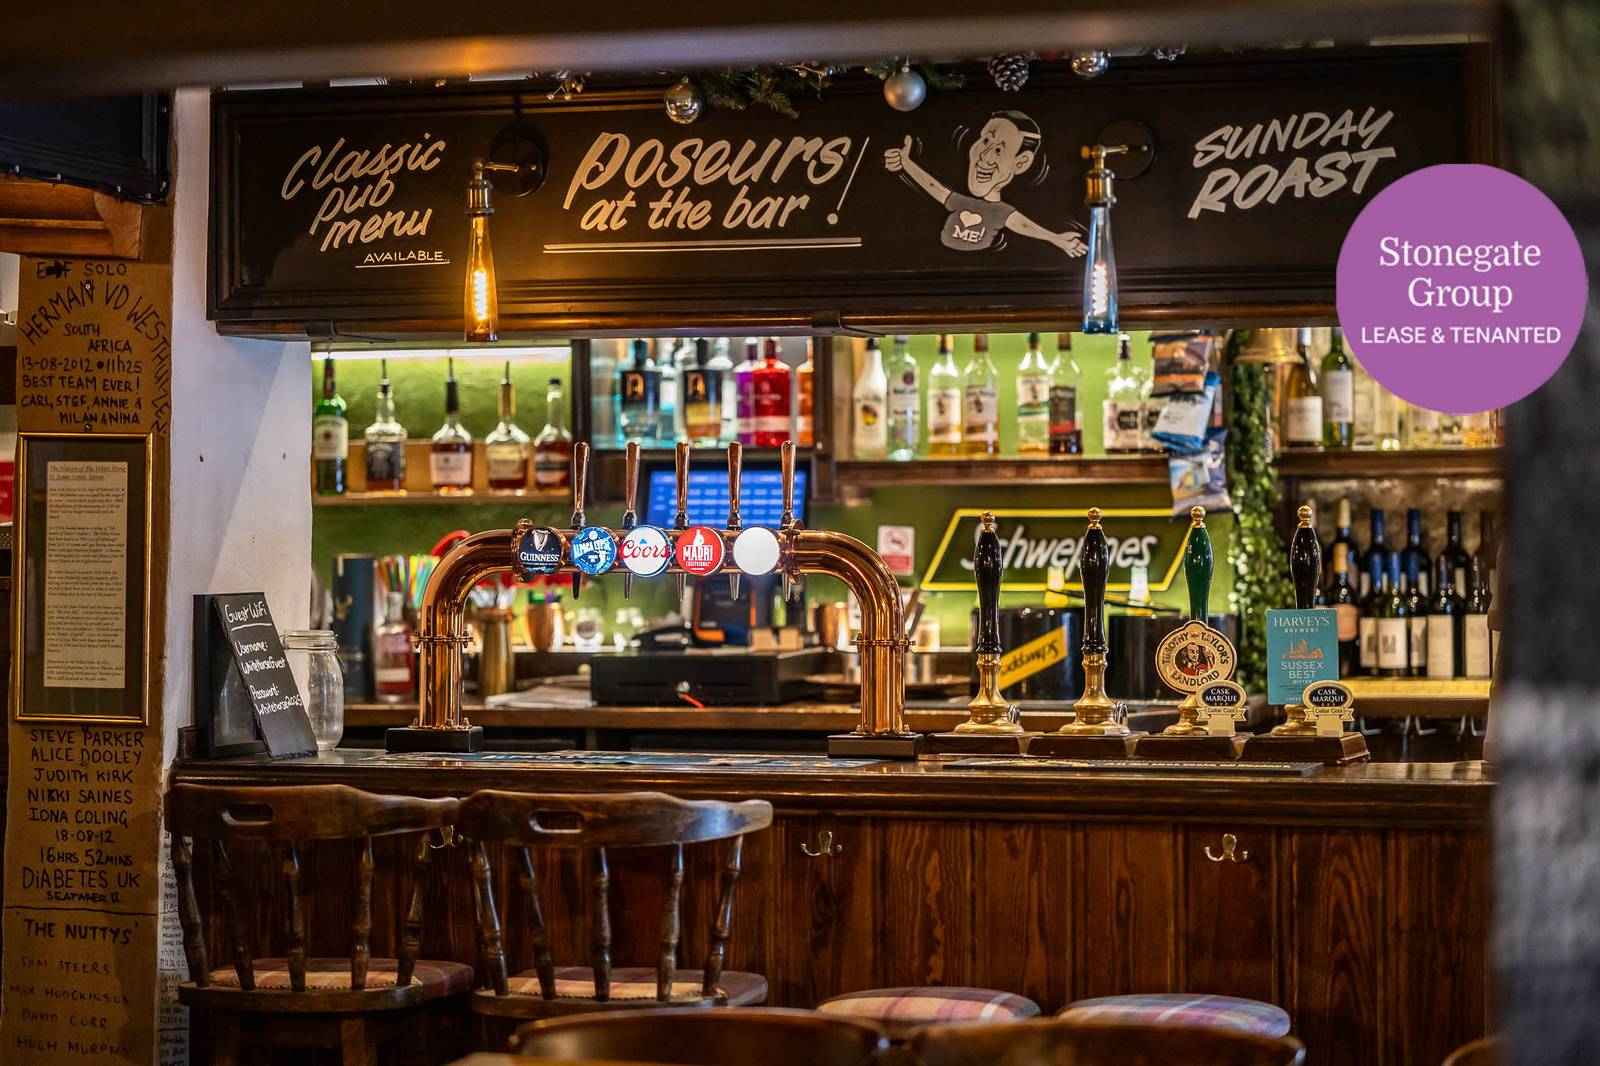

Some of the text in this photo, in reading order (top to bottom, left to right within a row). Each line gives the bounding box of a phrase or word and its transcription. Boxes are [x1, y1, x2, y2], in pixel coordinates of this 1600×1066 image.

[1192, 106, 1395, 169] SUNDAY
[281, 132, 446, 200] Classic
[1187, 146, 1396, 220] ROAST
[580, 191, 637, 232] at
[648, 185, 712, 231] the
[320, 207, 432, 252] menu
[952, 225, 986, 243] ME!
[84, 262, 127, 277] SOLO
[19, 279, 95, 346] HERMAN
[105, 280, 129, 310] VD
[63, 322, 100, 337] SOUTH
[87, 339, 133, 353] AFRICA
[22, 355, 142, 374] 13-08-2012 11h25
[23, 375, 54, 388] BEST
[58, 376, 96, 392] TEAM
[93, 397, 129, 409] ANNIE
[59, 412, 98, 425] MILAN
[520, 551, 560, 562] GUINNESS
[619, 539, 671, 559] Coors
[224, 603, 249, 623] Guest
[1273, 615, 1330, 628] HARVEY'S
[234, 639, 268, 657] Username:
[1161, 632, 1230, 665] TIMOTHY TAYLOR'S
[1281, 661, 1324, 670] SUSSEX
[1171, 670, 1220, 687] LANDLORD
[1288, 670, 1317, 679] BEST
[1205, 695, 1237, 703] MARQUE
[1210, 688, 1230, 696] CASK
[1312, 695, 1344, 703] MARQUE
[1317, 688, 1337, 696] CASK
[30, 729, 144, 748] STEVE PARKER
[30, 747, 142, 766] ALICE DOOLEY
[33, 767, 133, 784] JUDITH KIRK
[27, 788, 133, 804] NIKKI SAINES
[29, 807, 128, 829] IONA COLING
[40, 846, 133, 867] 16HRS 52MINS
[117, 871, 141, 889] UK
[59, 960, 110, 976] STEERS
[16, 1036, 57, 1052] HUGH
